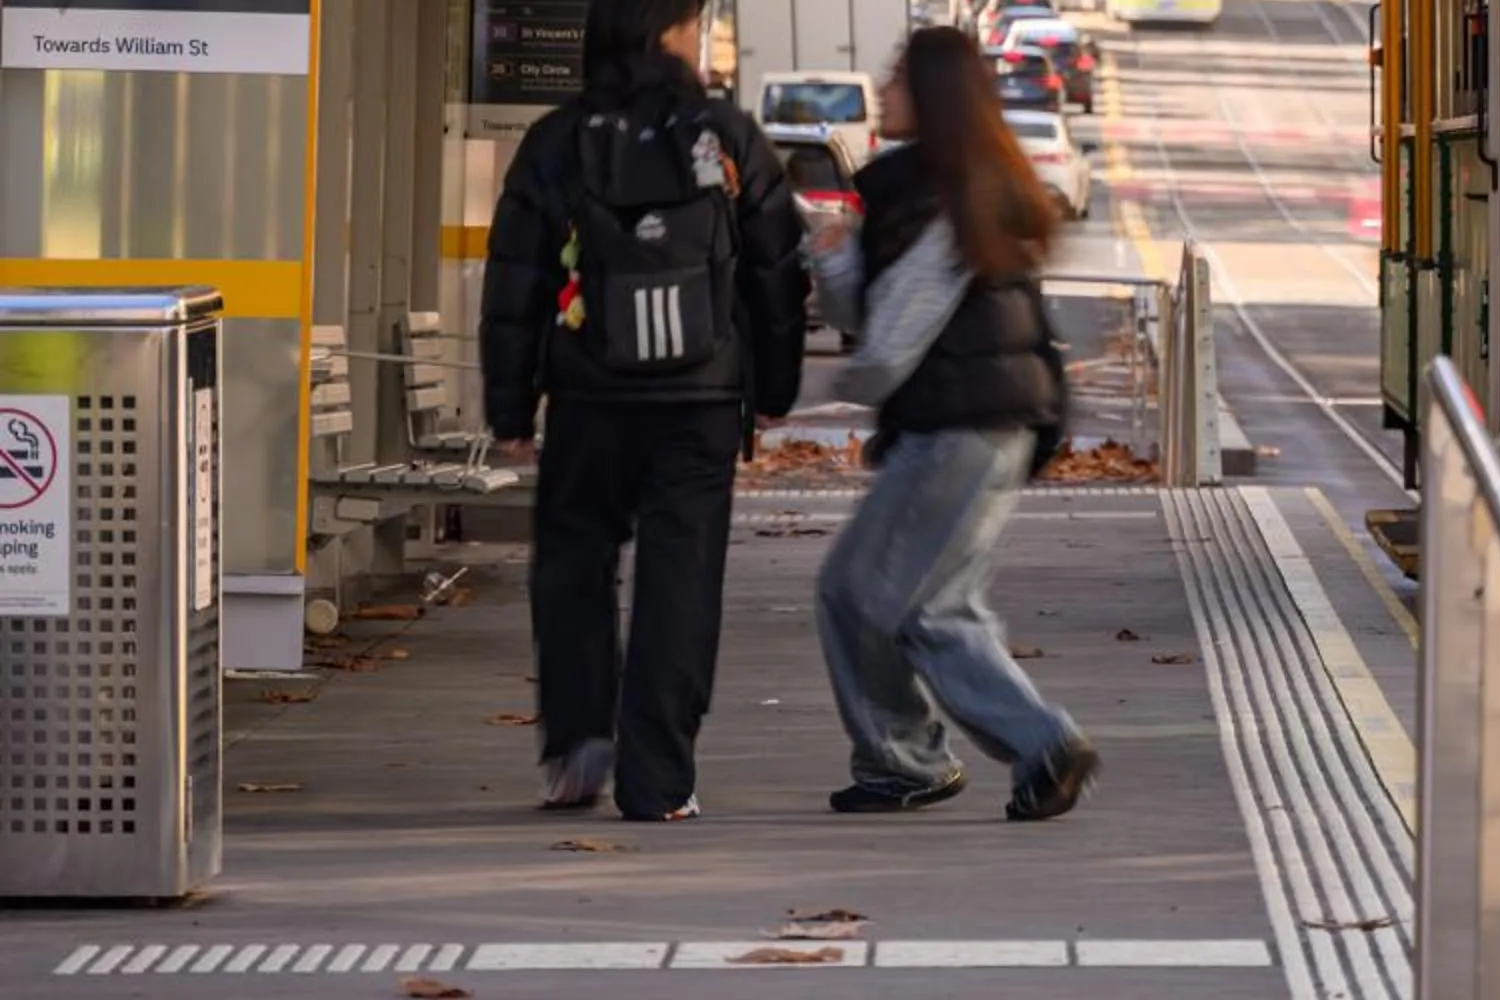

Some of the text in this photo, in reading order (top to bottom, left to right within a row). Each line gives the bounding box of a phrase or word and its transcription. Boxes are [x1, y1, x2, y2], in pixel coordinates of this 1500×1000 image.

[33, 34, 209, 57] Towards William St
[0, 538, 39, 560] ping
